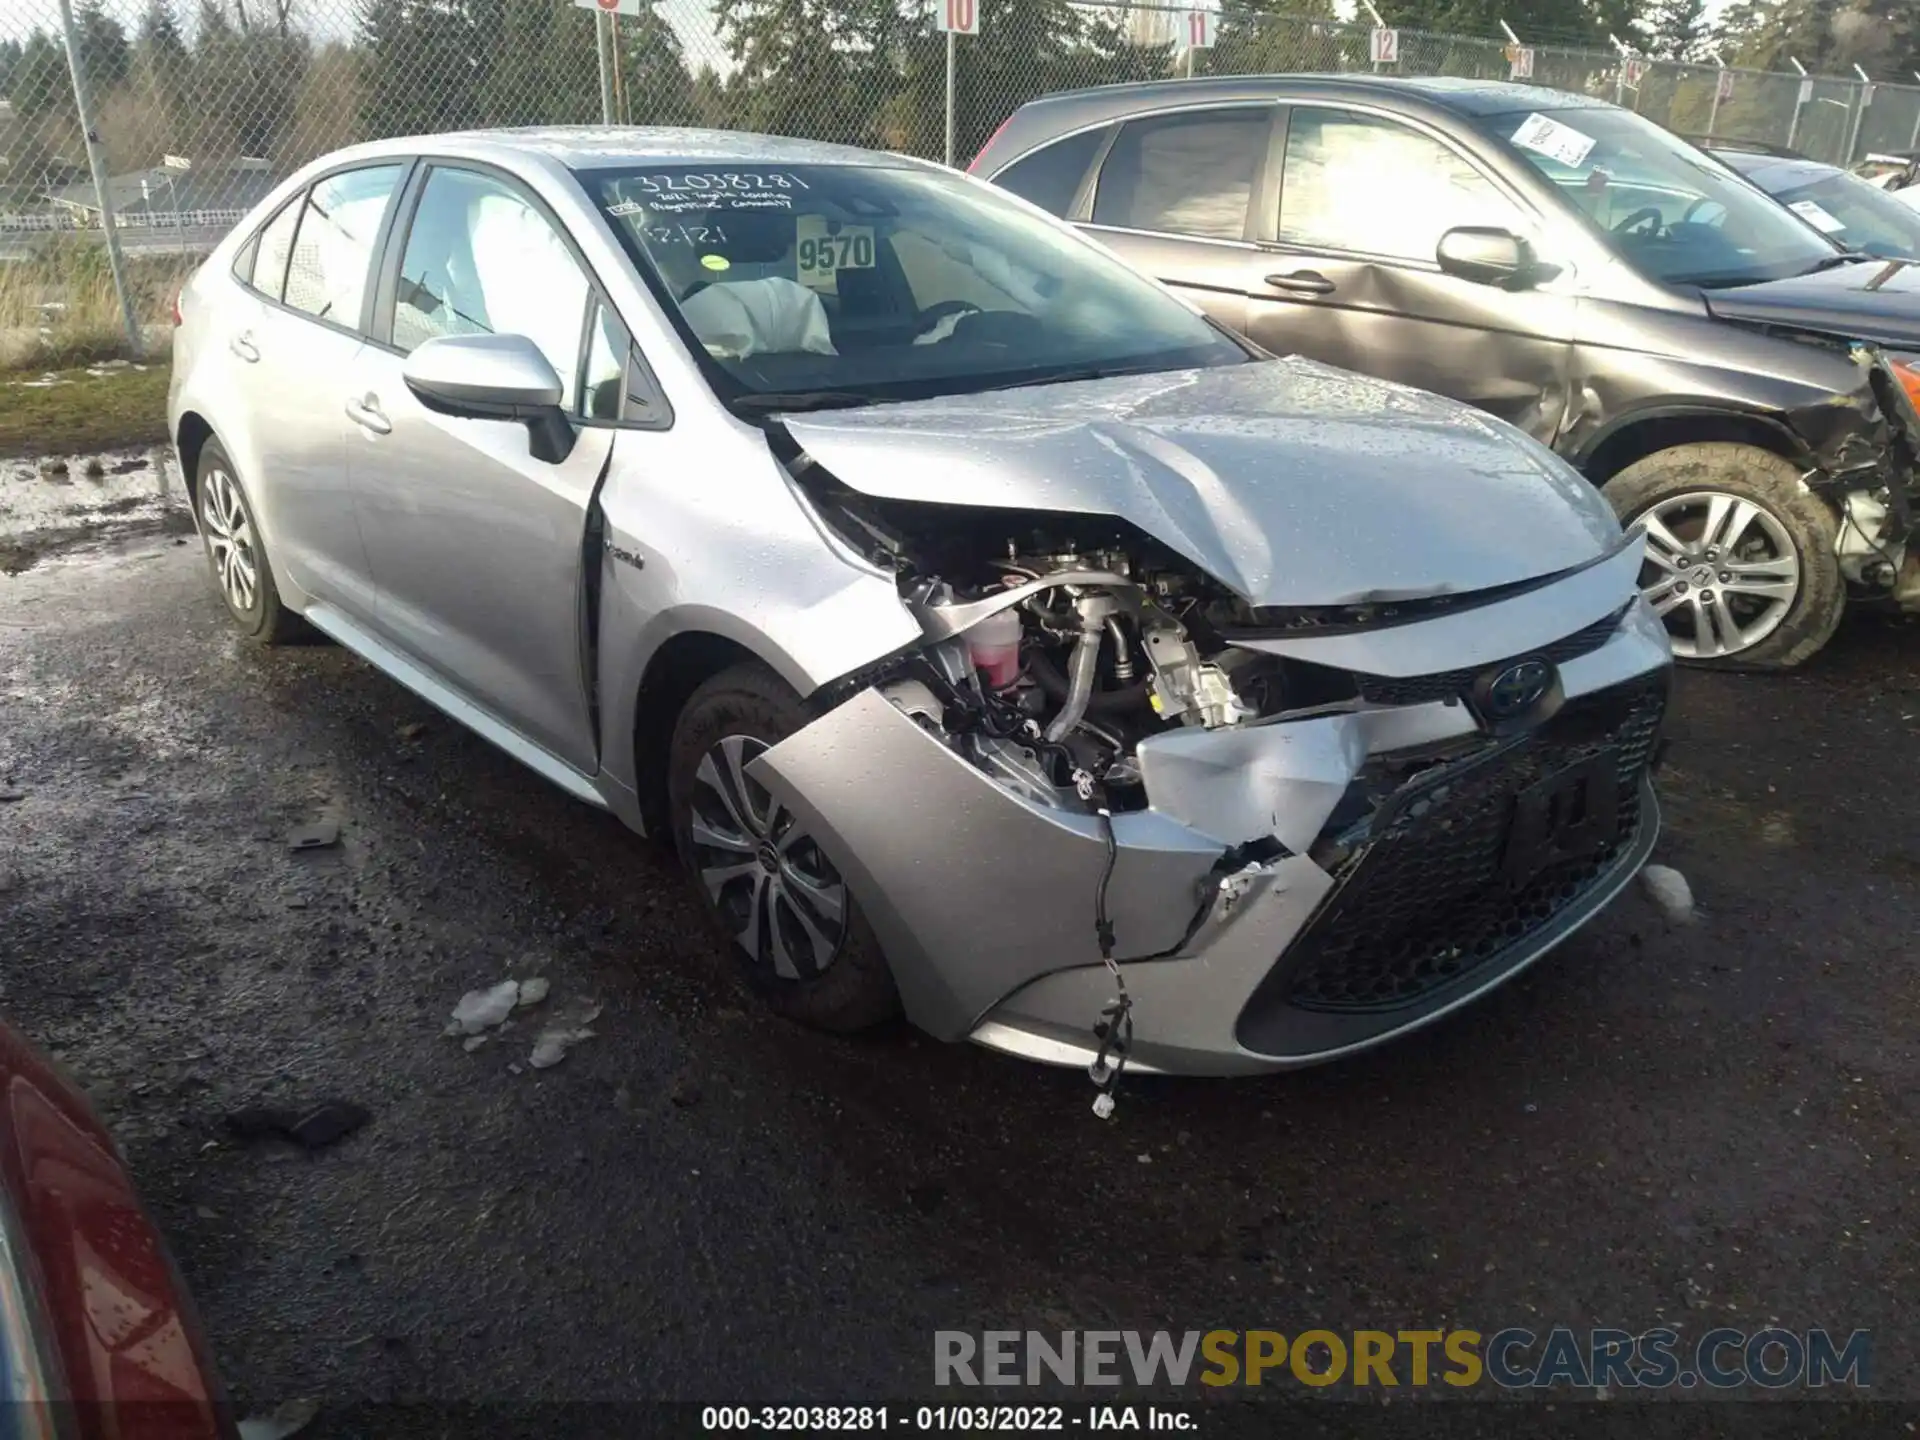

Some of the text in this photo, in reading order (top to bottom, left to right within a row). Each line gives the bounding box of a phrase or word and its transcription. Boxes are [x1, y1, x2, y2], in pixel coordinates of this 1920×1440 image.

[946, 0, 974, 31] 10
[1187, 12, 1206, 46] 11
[1375, 31, 1394, 60] 12
[634, 172, 810, 192] 32038281
[800, 235, 872, 271] 9570
